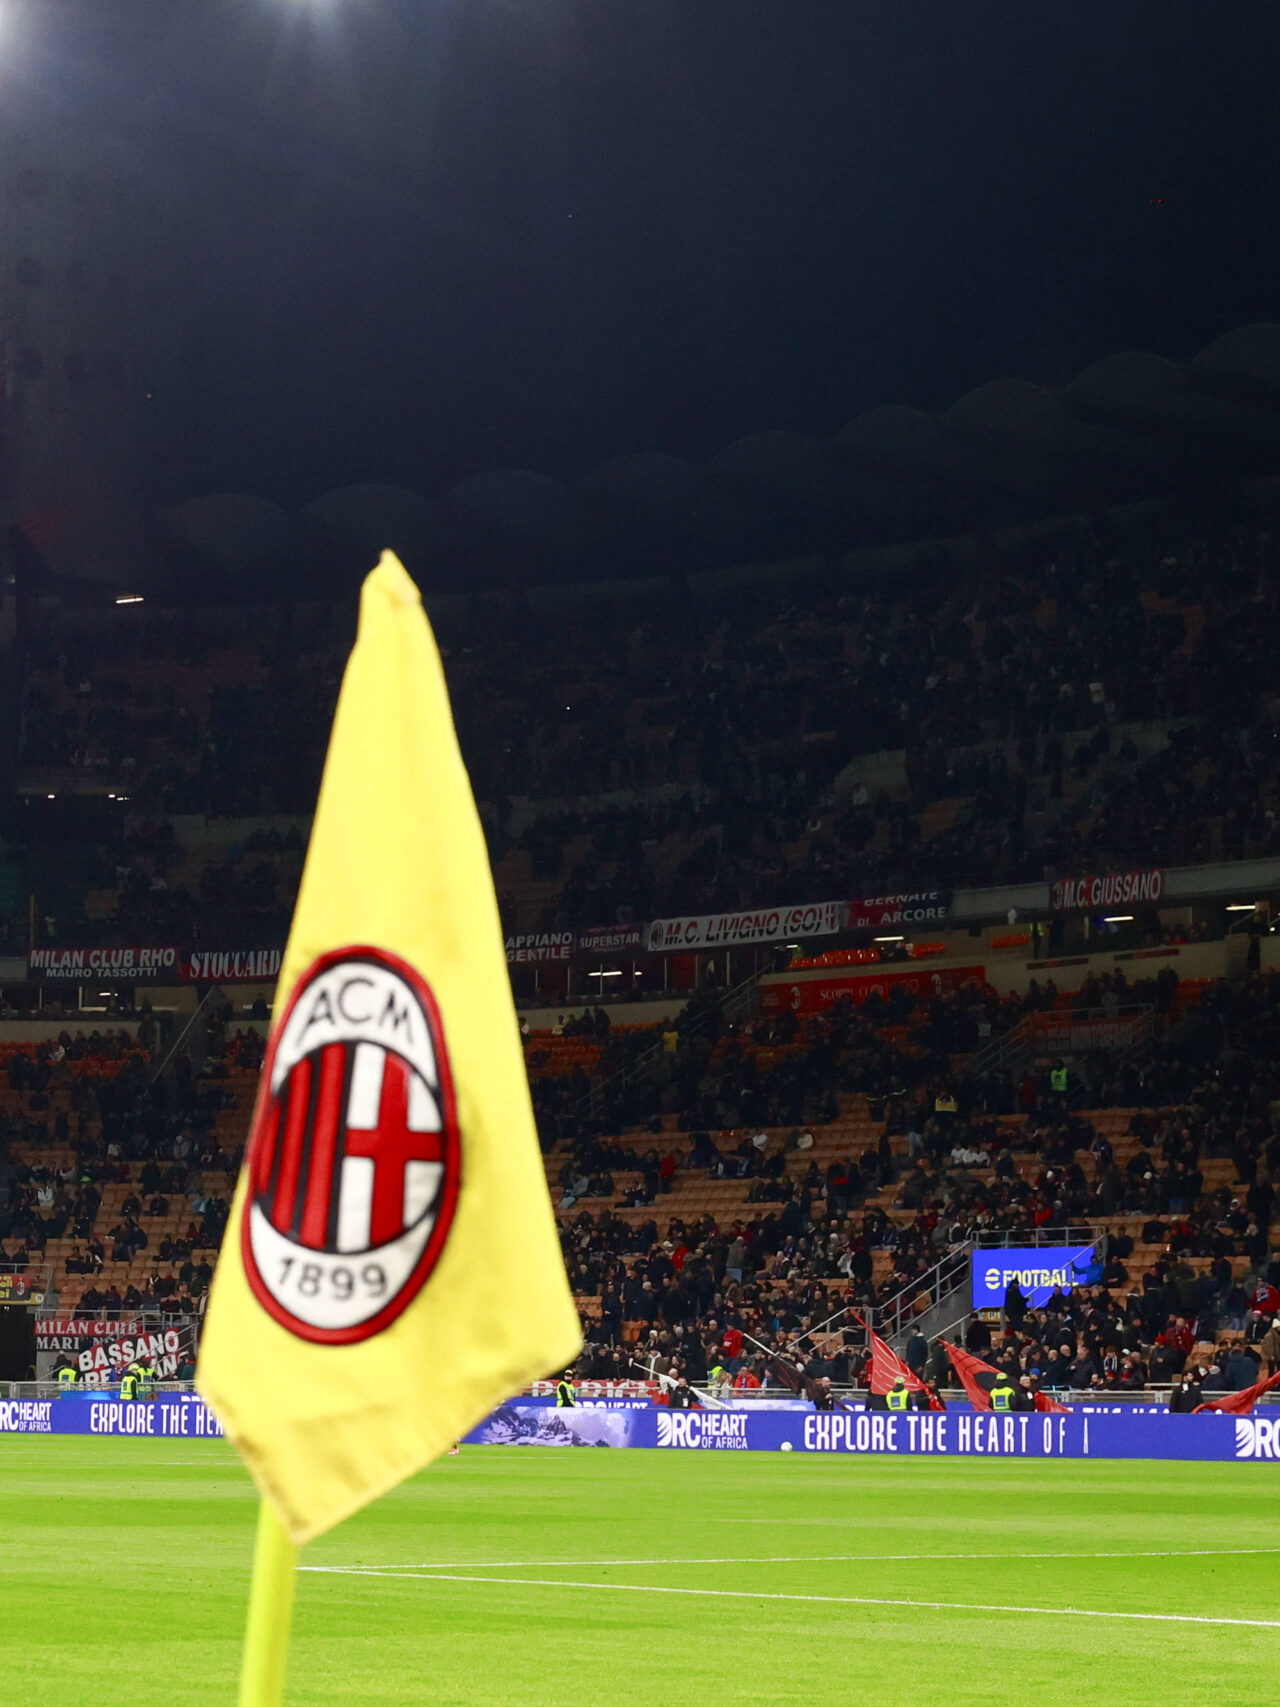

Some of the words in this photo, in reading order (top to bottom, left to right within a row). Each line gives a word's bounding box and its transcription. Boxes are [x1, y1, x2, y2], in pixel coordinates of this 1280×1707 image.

[1091, 872, 1162, 906] GIUSSANO
[880, 906, 947, 923] ARCORE
[505, 932, 573, 948] APPIANO
[665, 922, 700, 945] M.C.
[706, 915, 780, 942] LIVIGNO
[579, 933, 640, 948] SUPERSTAR
[30, 950, 85, 968] MILAN
[89, 949, 134, 968] CLUB
[140, 948, 176, 967] RHO
[507, 945, 572, 961] GENTILE
[46, 968, 92, 978] MAURO
[98, 967, 158, 977] TASSOTTI
[190, 950, 282, 978] STOCCARD
[297, 977, 414, 1046] ACM
[279, 1258, 387, 1300] 1899
[35, 1321, 88, 1334] MILAN
[94, 1322, 138, 1335] CLUB
[78, 1331, 179, 1377] BASSANO
[19, 1402, 52, 1421] HEART
[90, 1403, 155, 1433] EXPLORE
[161, 1404, 188, 1434] THE
[19, 1421, 28, 1432] OF
[28, 1421, 52, 1433] AFRICA
[702, 1413, 748, 1436] HEART
[804, 1414, 898, 1450] EXPLORE
[907, 1415, 947, 1451] THE
[959, 1416, 1029, 1453] HEART
[1043, 1417, 1065, 1454] OF
[702, 1437, 714, 1449] OF
[715, 1437, 748, 1450] AFRICA
